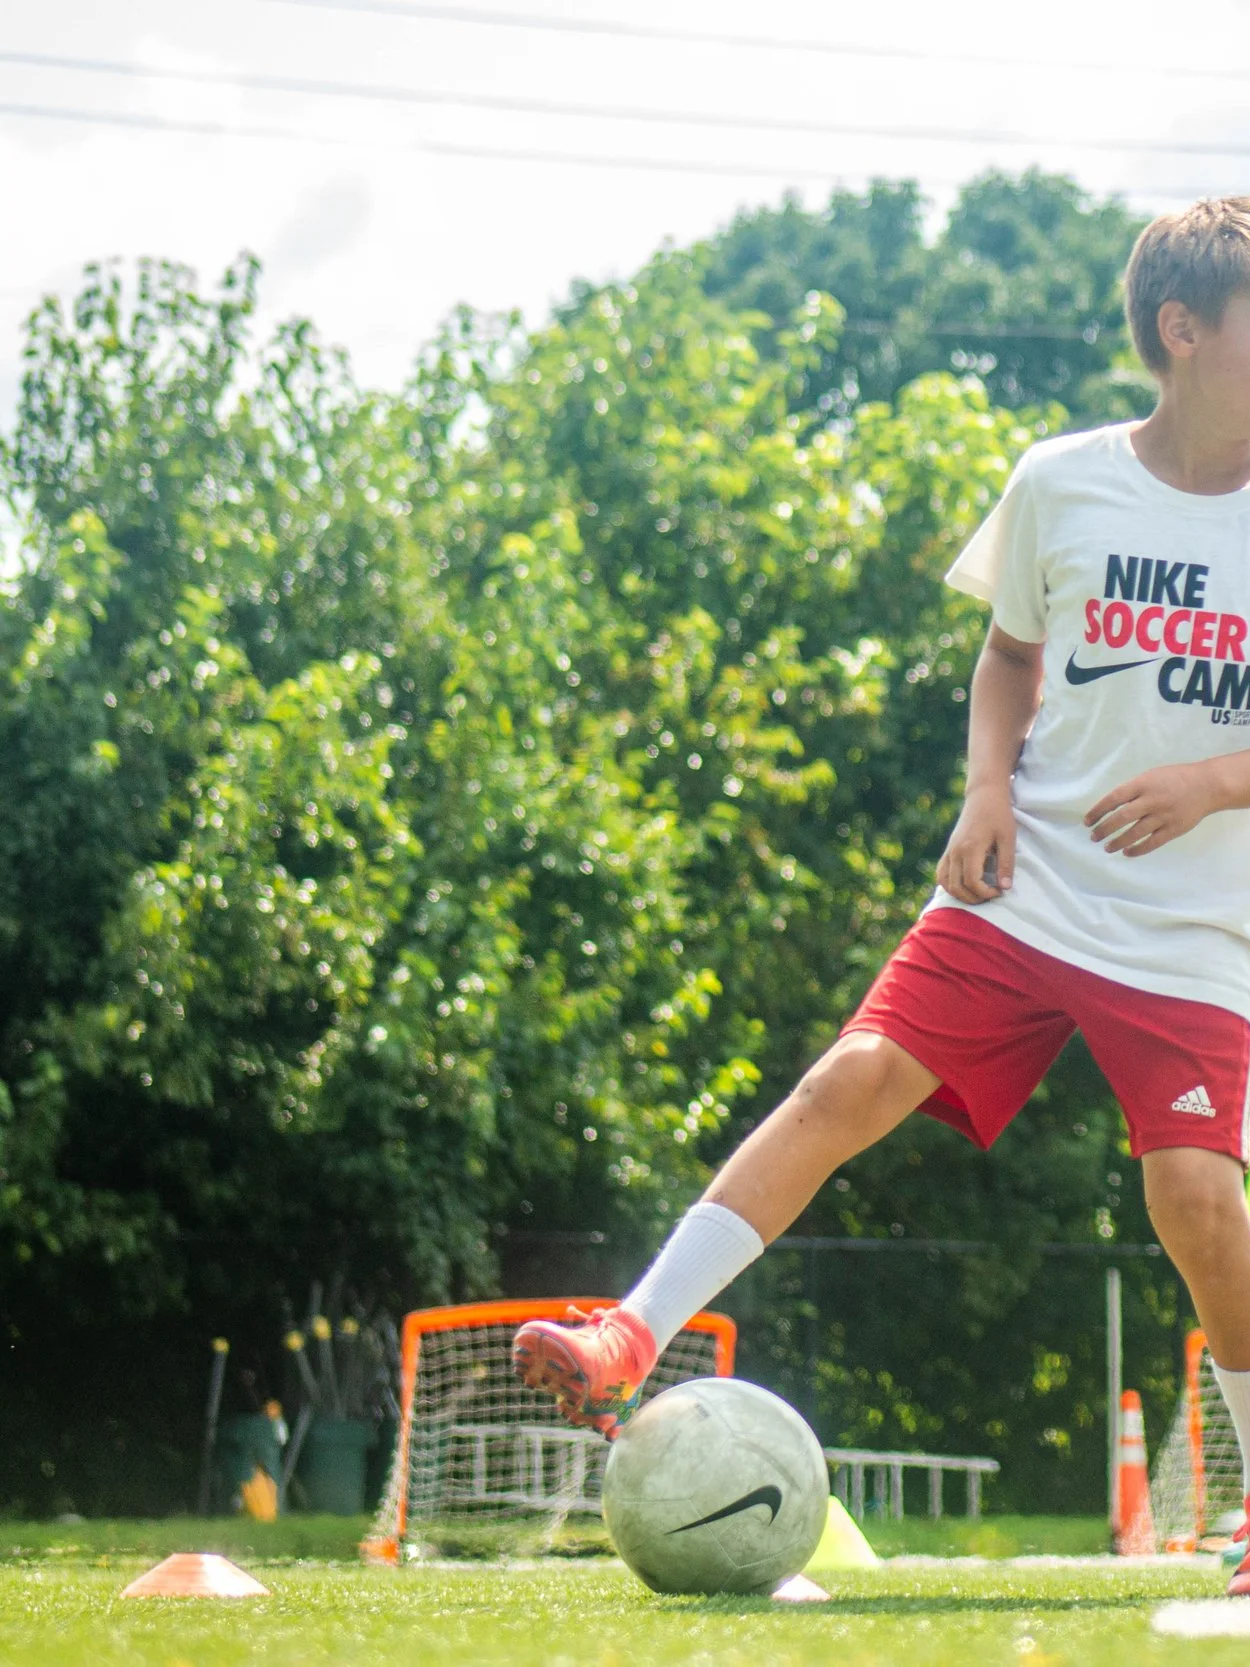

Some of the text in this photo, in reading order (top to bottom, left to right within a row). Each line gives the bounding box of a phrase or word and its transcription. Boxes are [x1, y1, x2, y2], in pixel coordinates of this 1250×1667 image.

[1103, 553, 1210, 609] NIKE
[1084, 598, 1248, 662] SOCCER
[1211, 708, 1231, 725] US
[1171, 1101, 1217, 1119] adidas
